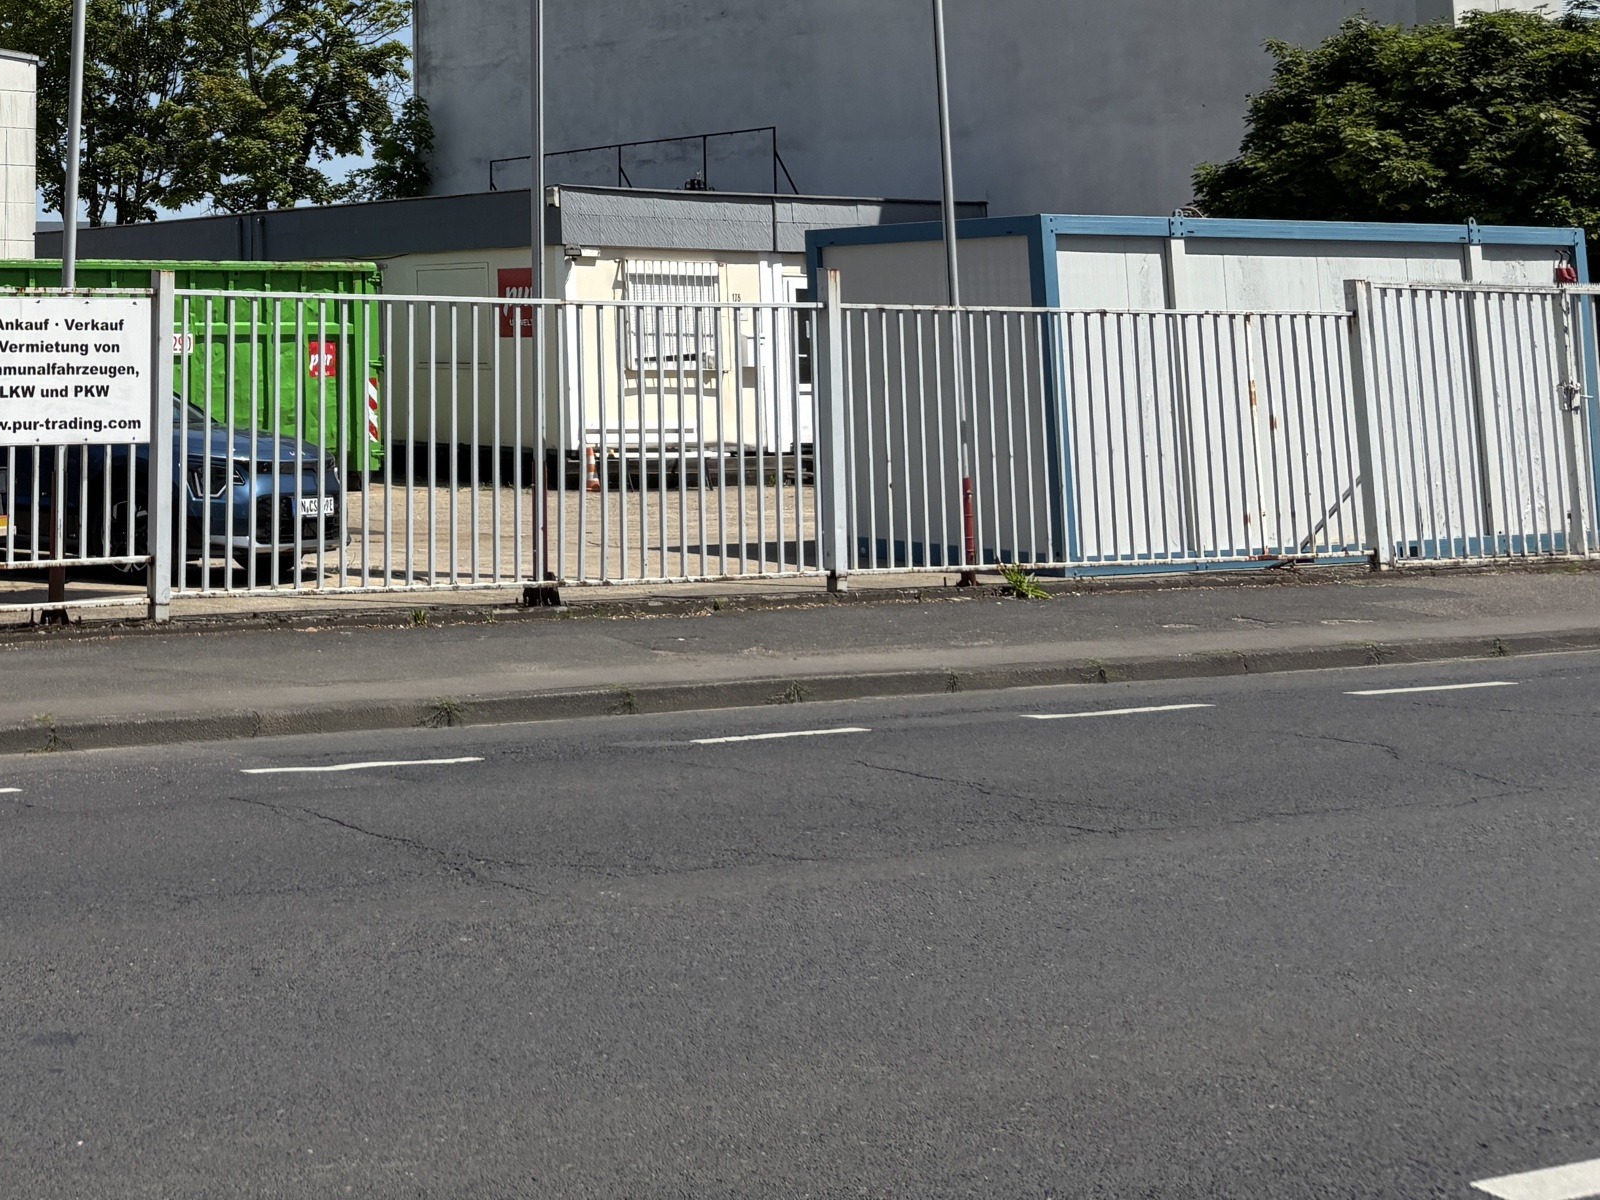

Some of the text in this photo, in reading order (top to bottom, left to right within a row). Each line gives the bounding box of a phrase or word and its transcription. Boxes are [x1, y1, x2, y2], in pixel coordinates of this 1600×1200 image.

[64, 318, 124, 331] Verkauf
[93, 343, 120, 353] von
[0, 385, 110, 398] LKW und PKW
